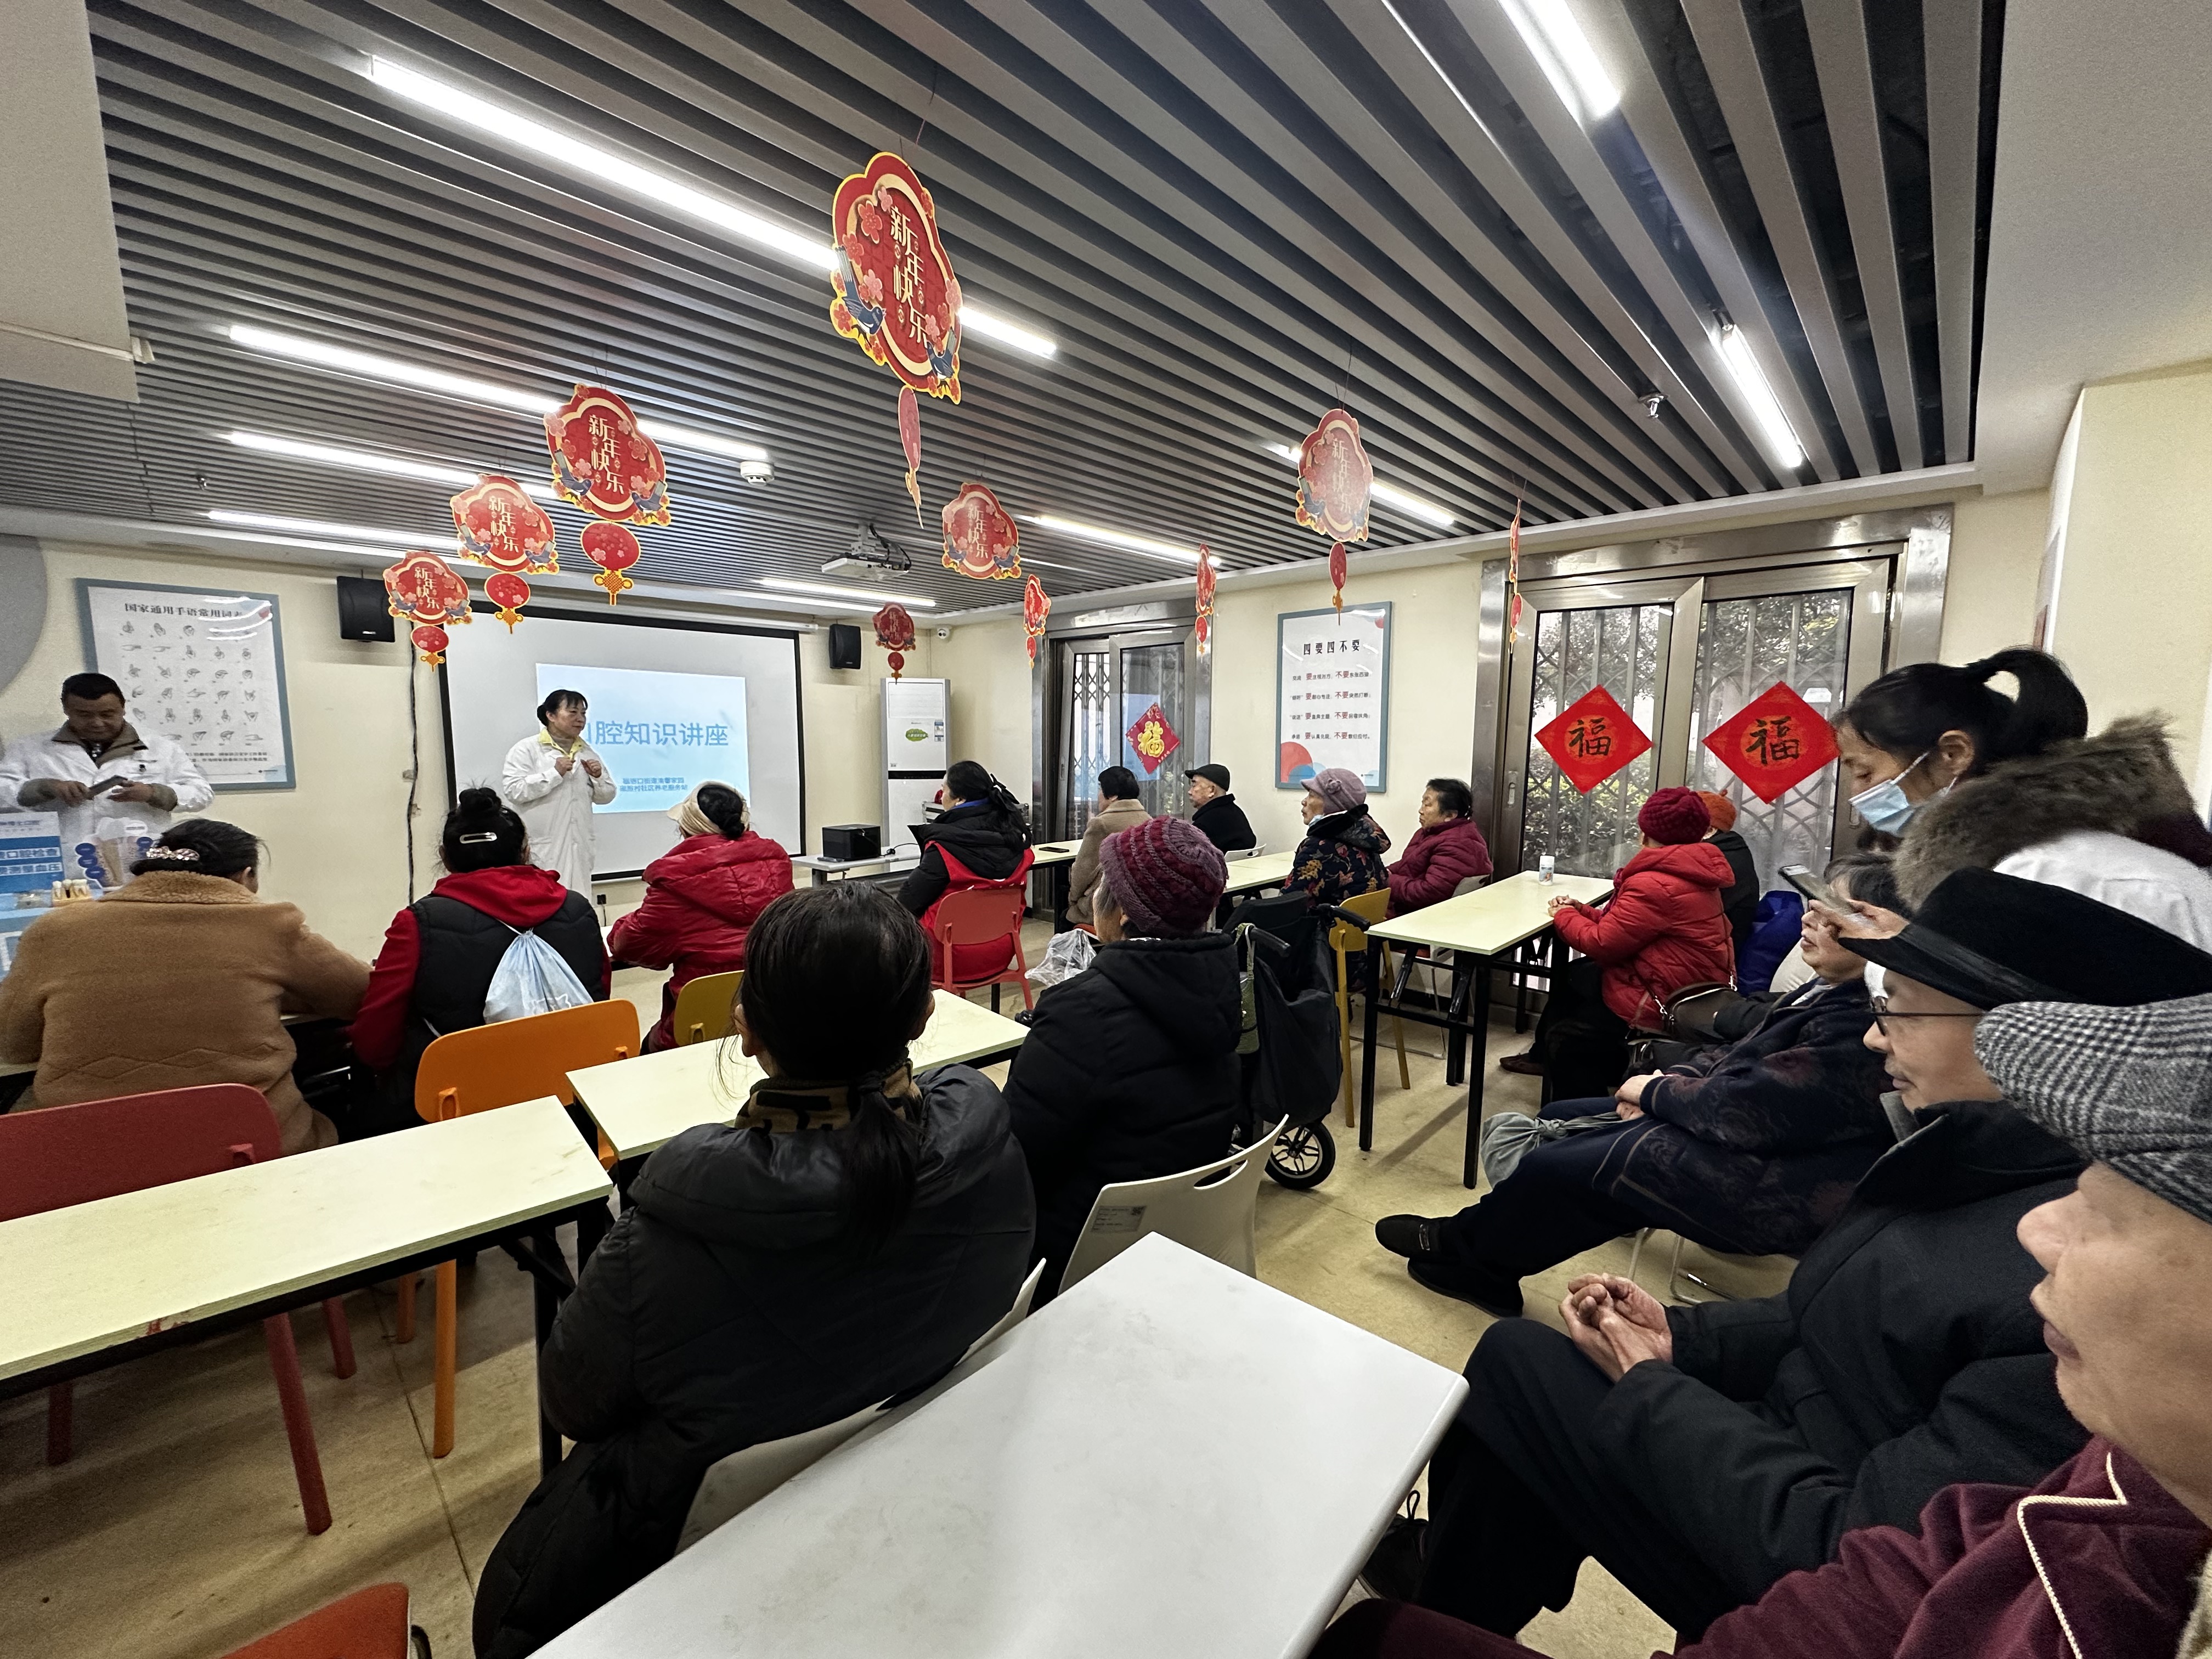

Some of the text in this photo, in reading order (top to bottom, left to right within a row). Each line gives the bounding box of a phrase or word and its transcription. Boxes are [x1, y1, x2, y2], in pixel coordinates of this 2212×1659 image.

[889, 205, 928, 347] 新年快乐
[588, 414, 624, 495] 新年快乐
[1331, 438, 1351, 514] 新年快乐
[488, 495, 519, 554] 新年快乐
[967, 503, 989, 559] 新年快乐
[413, 566, 441, 610] 新年快乐
[1303, 639, 1361, 656] 四要四不要
[586, 720, 729, 747] 腔知识讲座
[1137, 721, 1165, 758] 福
[1568, 718, 1612, 758] 福
[1747, 715, 1800, 765] 福
